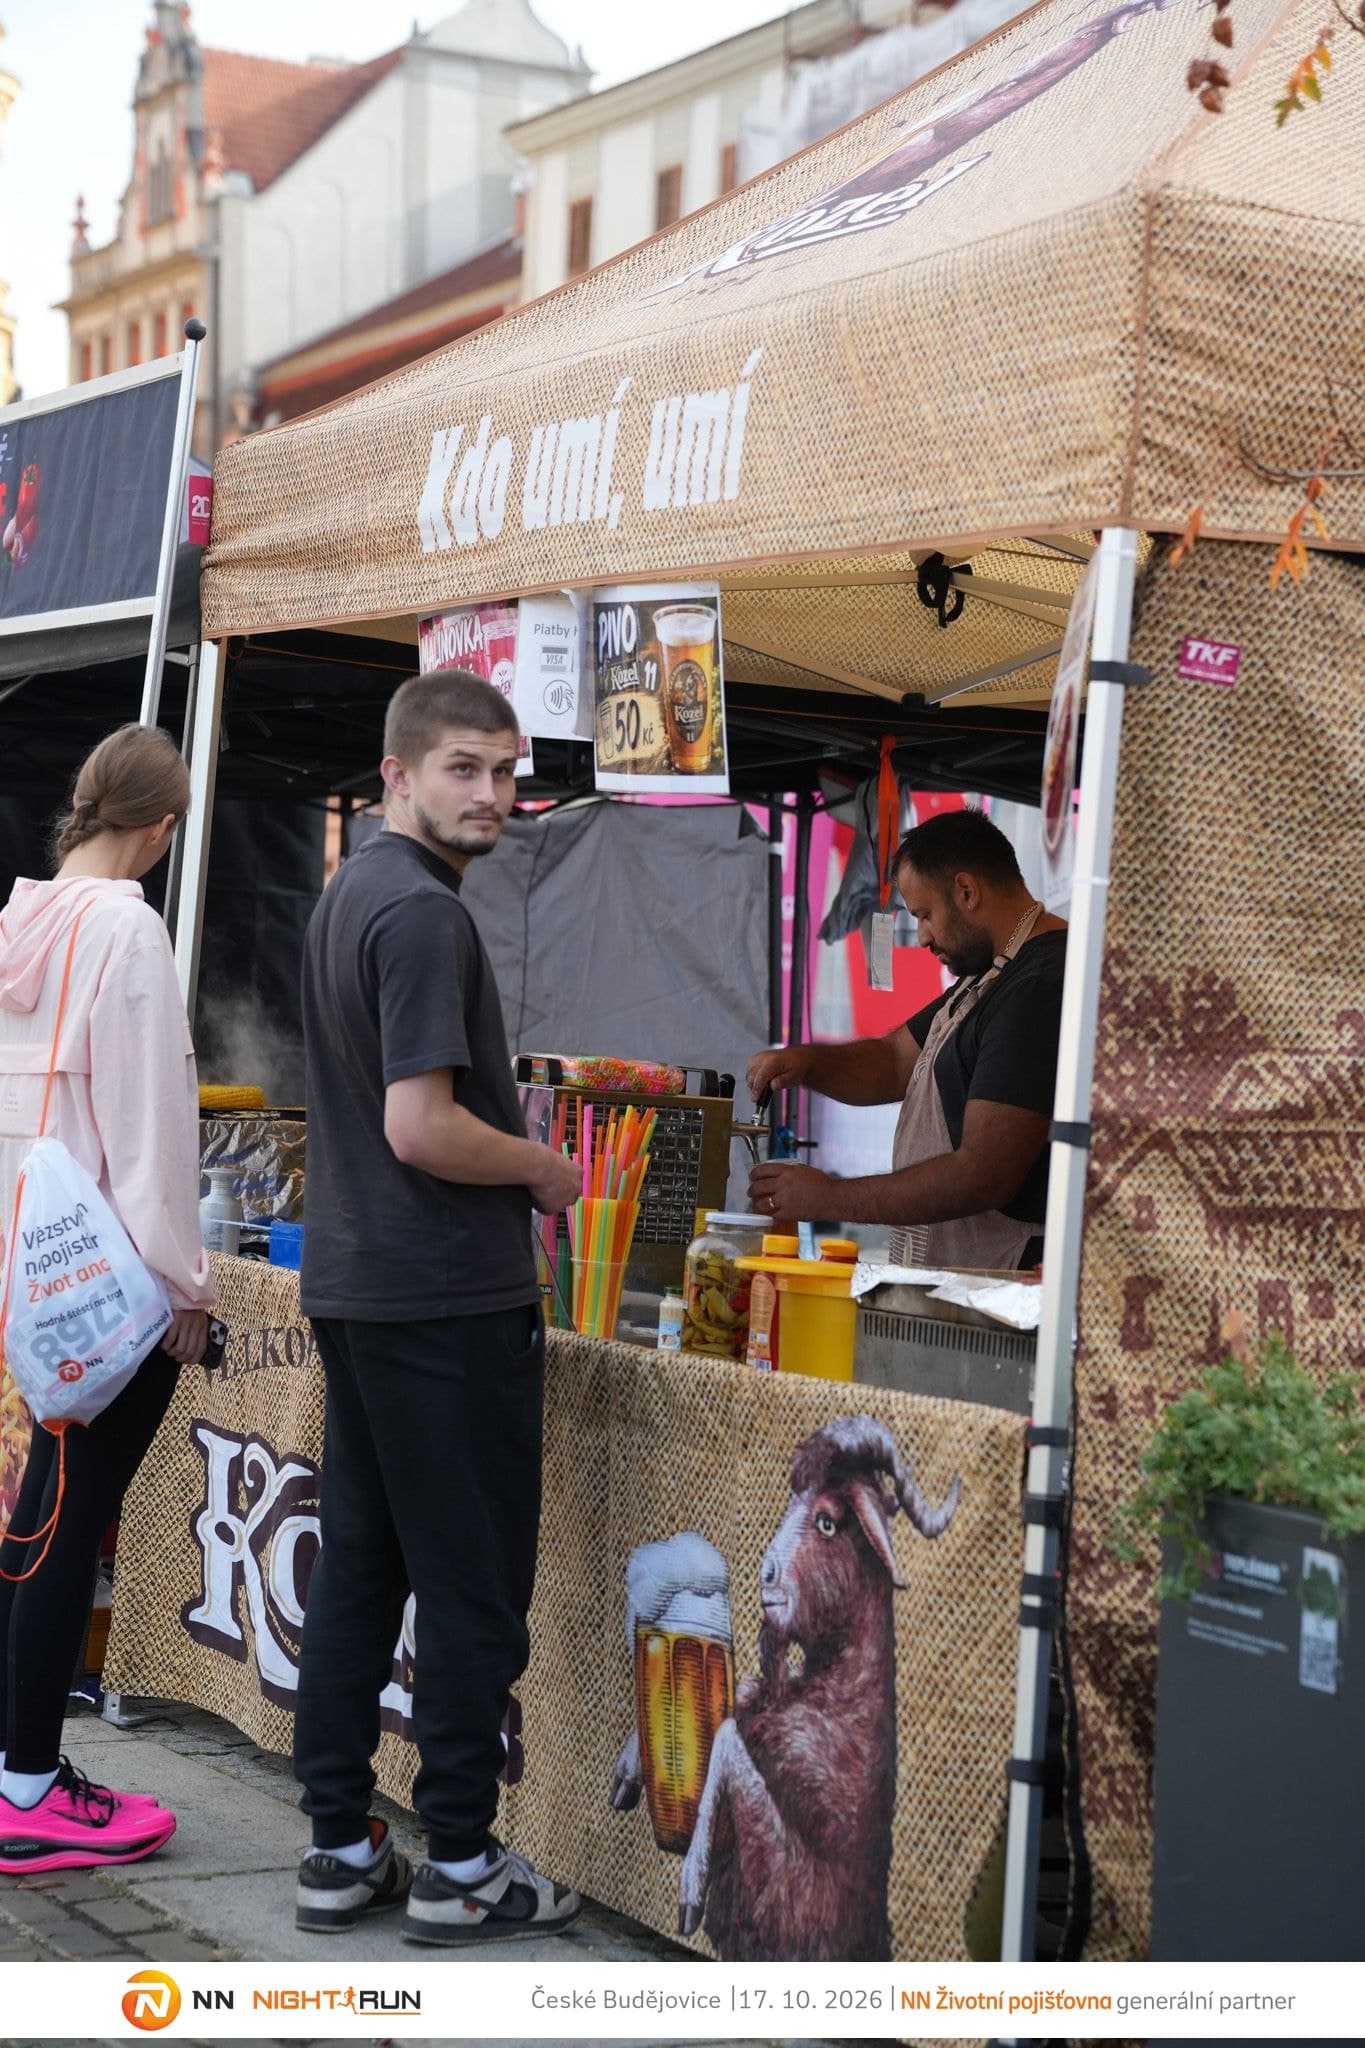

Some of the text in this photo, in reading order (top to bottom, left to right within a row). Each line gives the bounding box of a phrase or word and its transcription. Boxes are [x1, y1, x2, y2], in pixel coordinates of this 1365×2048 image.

[417, 347, 764, 554] Kdo umí, umí
[534, 623, 570, 638] Platby
[598, 604, 637, 665] PIVO
[545, 654, 564, 666] VISA
[1187, 640, 1239, 666] TKF
[610, 663, 641, 691] Kozel
[643, 660, 657, 691] 11
[616, 698, 640, 752] 50
[674, 704, 705, 723] Kozel
[84, 1355, 104, 1369] NN
